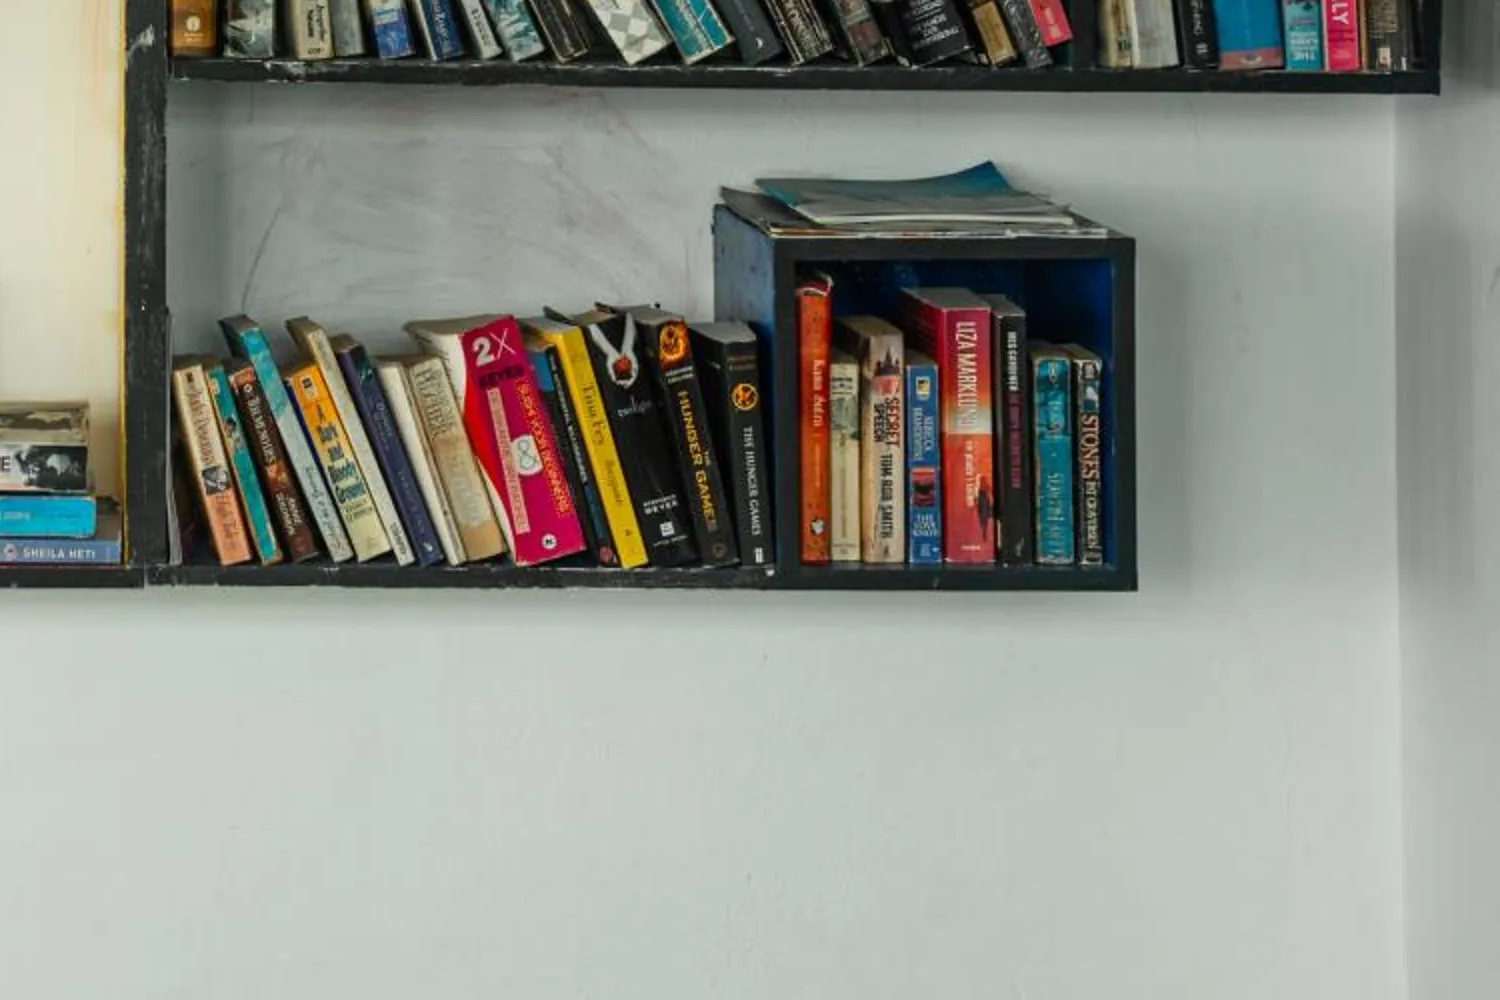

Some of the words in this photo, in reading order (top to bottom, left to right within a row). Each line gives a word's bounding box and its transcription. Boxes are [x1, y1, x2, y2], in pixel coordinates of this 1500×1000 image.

[956, 321, 976, 350] LIZA
[677, 389, 703, 467] HUNGER
[742, 426, 754, 447] THE
[873, 403, 887, 443] SPEECH
[884, 396, 901, 448] SECRET
[880, 453, 894, 477] TOM
[1080, 413, 1099, 479] STONES
[744, 450, 760, 496] HUNGER
[880, 478, 894, 500] ROB
[749, 497, 764, 537] GAMES
[880, 502, 894, 540] SMITH
[23, 548, 65, 559] SHEILA
[69, 548, 96, 560] HETI
